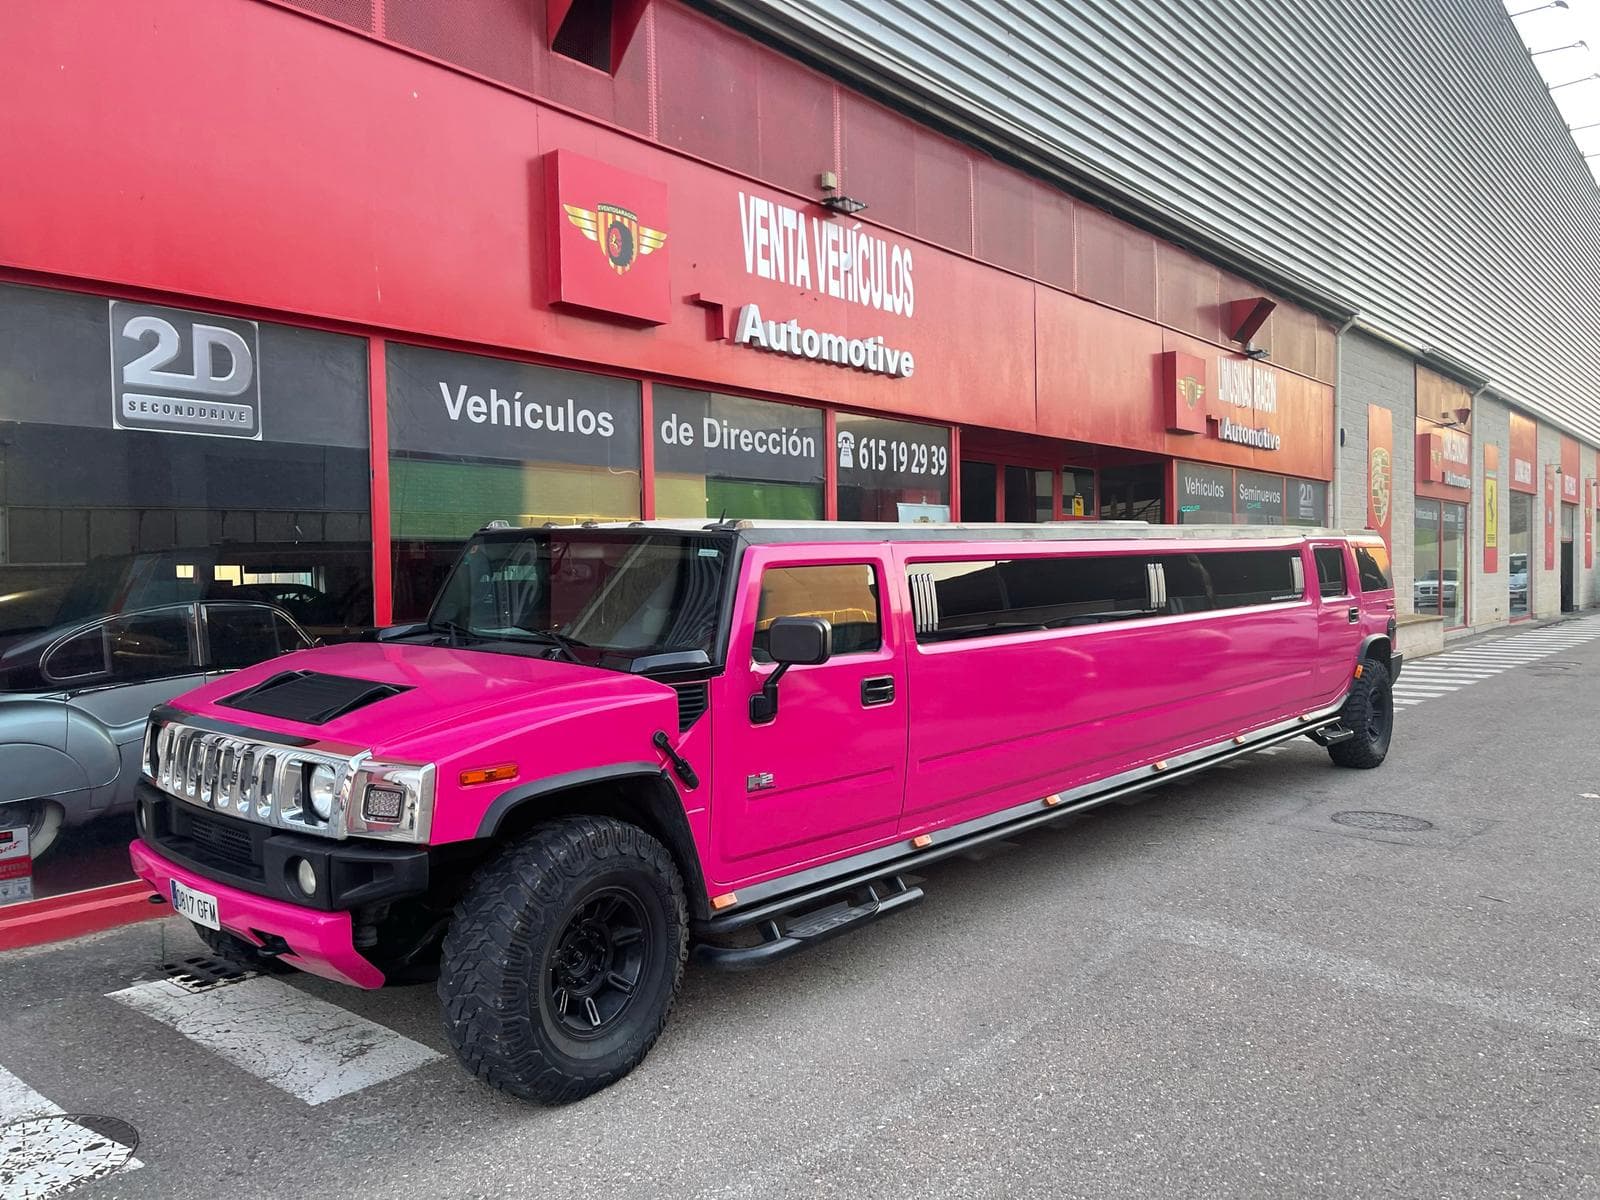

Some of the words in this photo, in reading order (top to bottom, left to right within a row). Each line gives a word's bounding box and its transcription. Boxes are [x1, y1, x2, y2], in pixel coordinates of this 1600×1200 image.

[738, 192, 812, 290] VENTA
[812, 218, 914, 318] VEHÍCULOS
[122, 316, 253, 396] 2D
[735, 303, 914, 378] Automotive
[128, 400, 247, 423] SECONDDRIVE
[439, 382, 615, 437] Vehículos
[661, 413, 694, 446] de
[703, 417, 815, 458] Dirección
[1221, 416, 1281, 451] Automotive
[859, 437, 887, 472] 615
[891, 440, 908, 473] 19
[911, 443, 928, 474] 29
[931, 445, 947, 476] 39
[1184, 476, 1225, 498] Vehículos
[1239, 483, 1281, 504] Seminuevos
